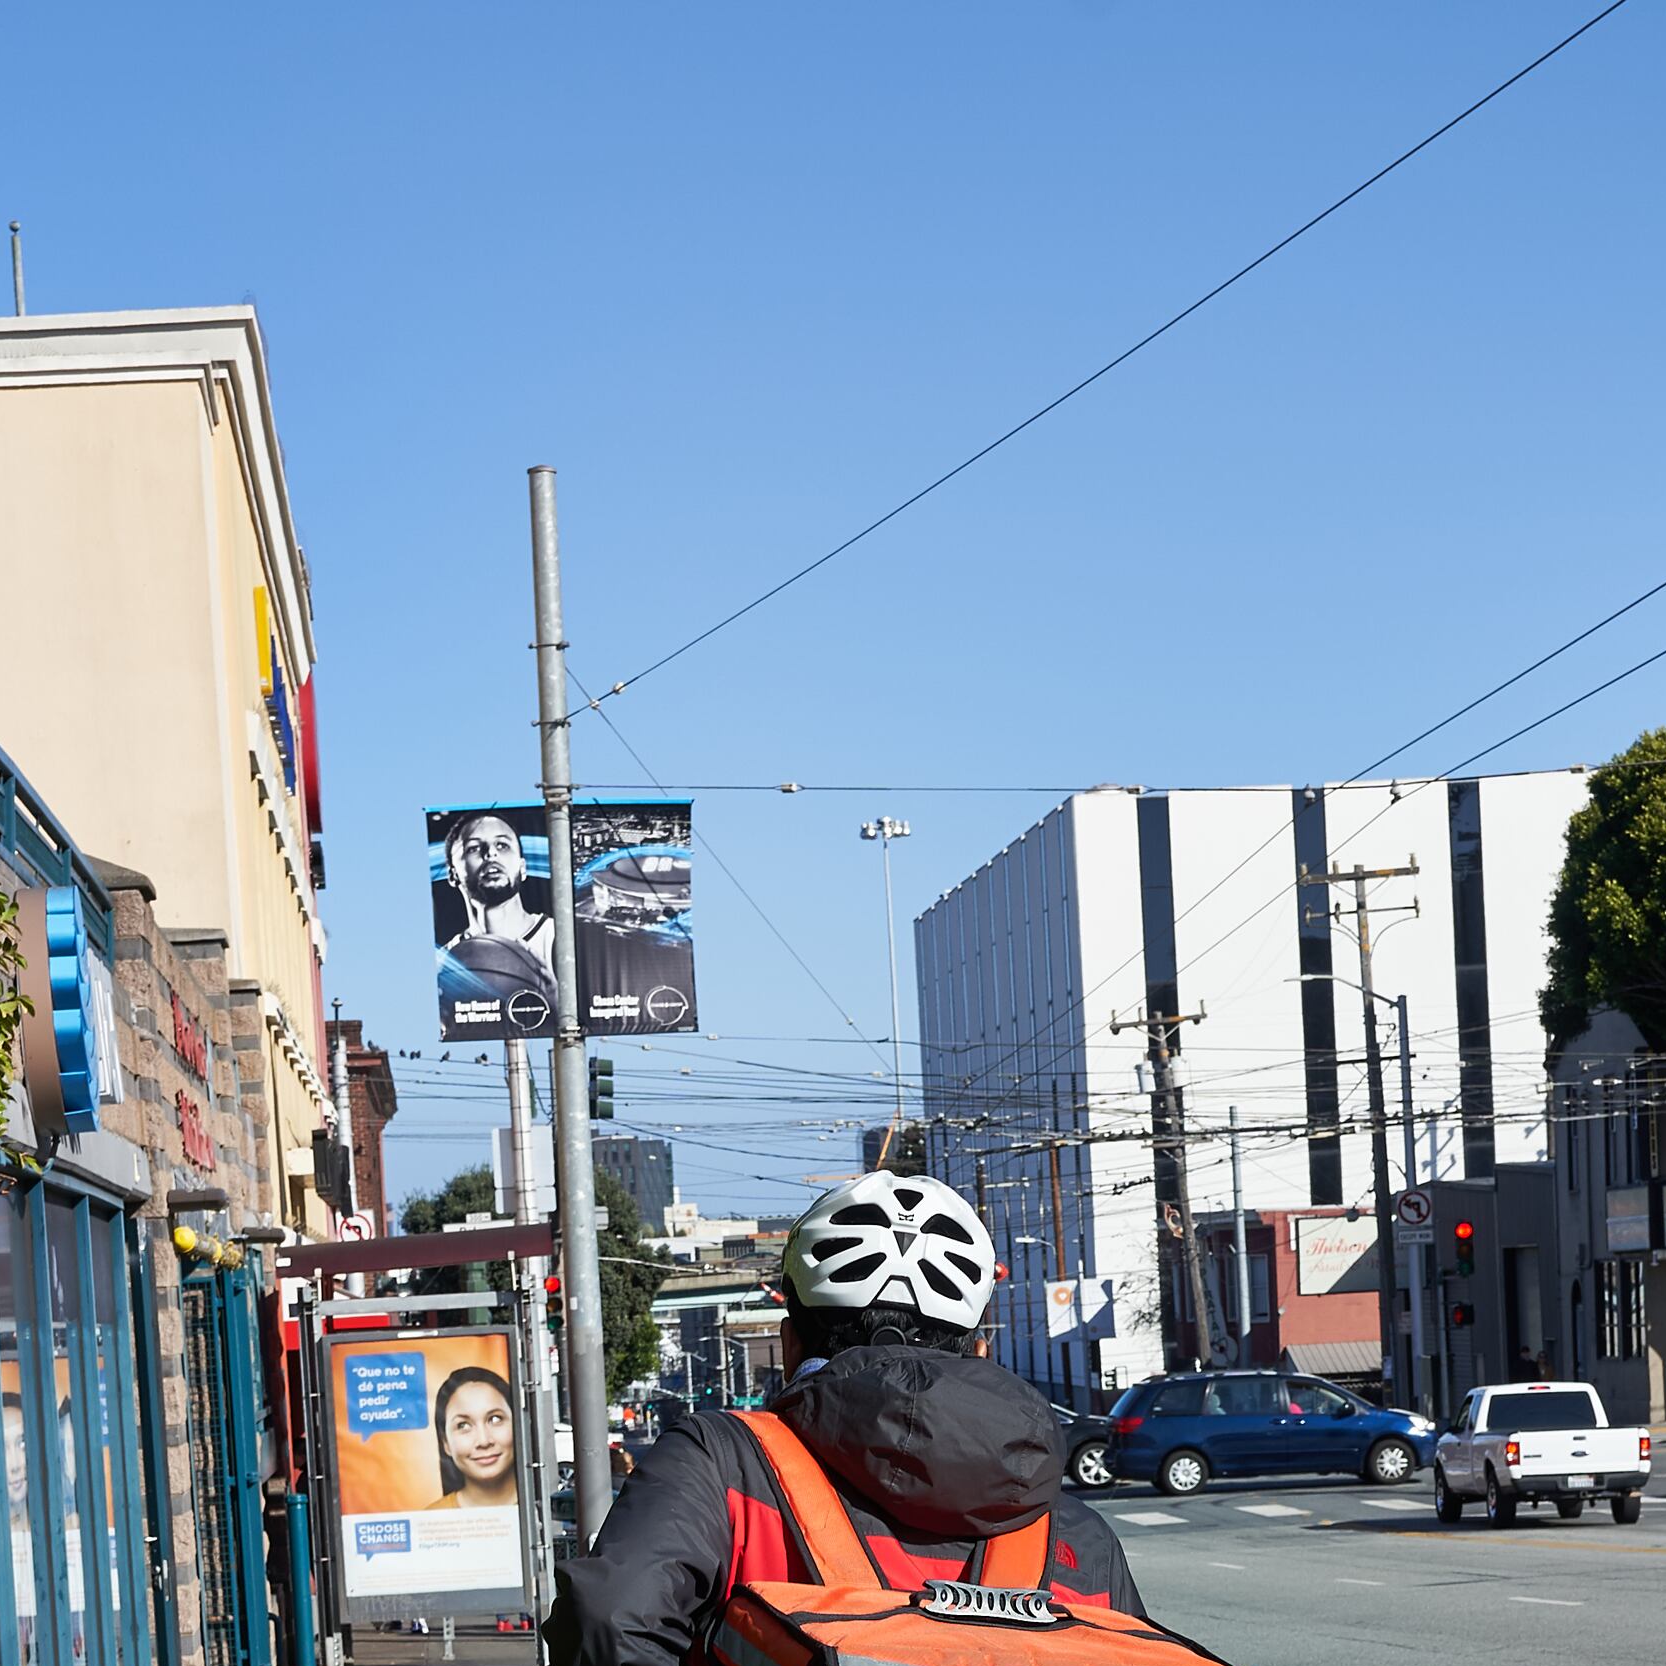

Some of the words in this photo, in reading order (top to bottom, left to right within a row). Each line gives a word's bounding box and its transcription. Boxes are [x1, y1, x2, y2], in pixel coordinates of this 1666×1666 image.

[614, 994, 640, 1006] Center
[468, 1012, 502, 1023] Warriors
[384, 1367, 400, 1376] no
[403, 1365, 416, 1376] te
[358, 1381, 374, 1392] dé
[377, 1381, 407, 1393] pena
[359, 1395, 390, 1408] pedir
[358, 1522, 406, 1534] CHOOSE
[359, 1533, 407, 1544] CHANGE
